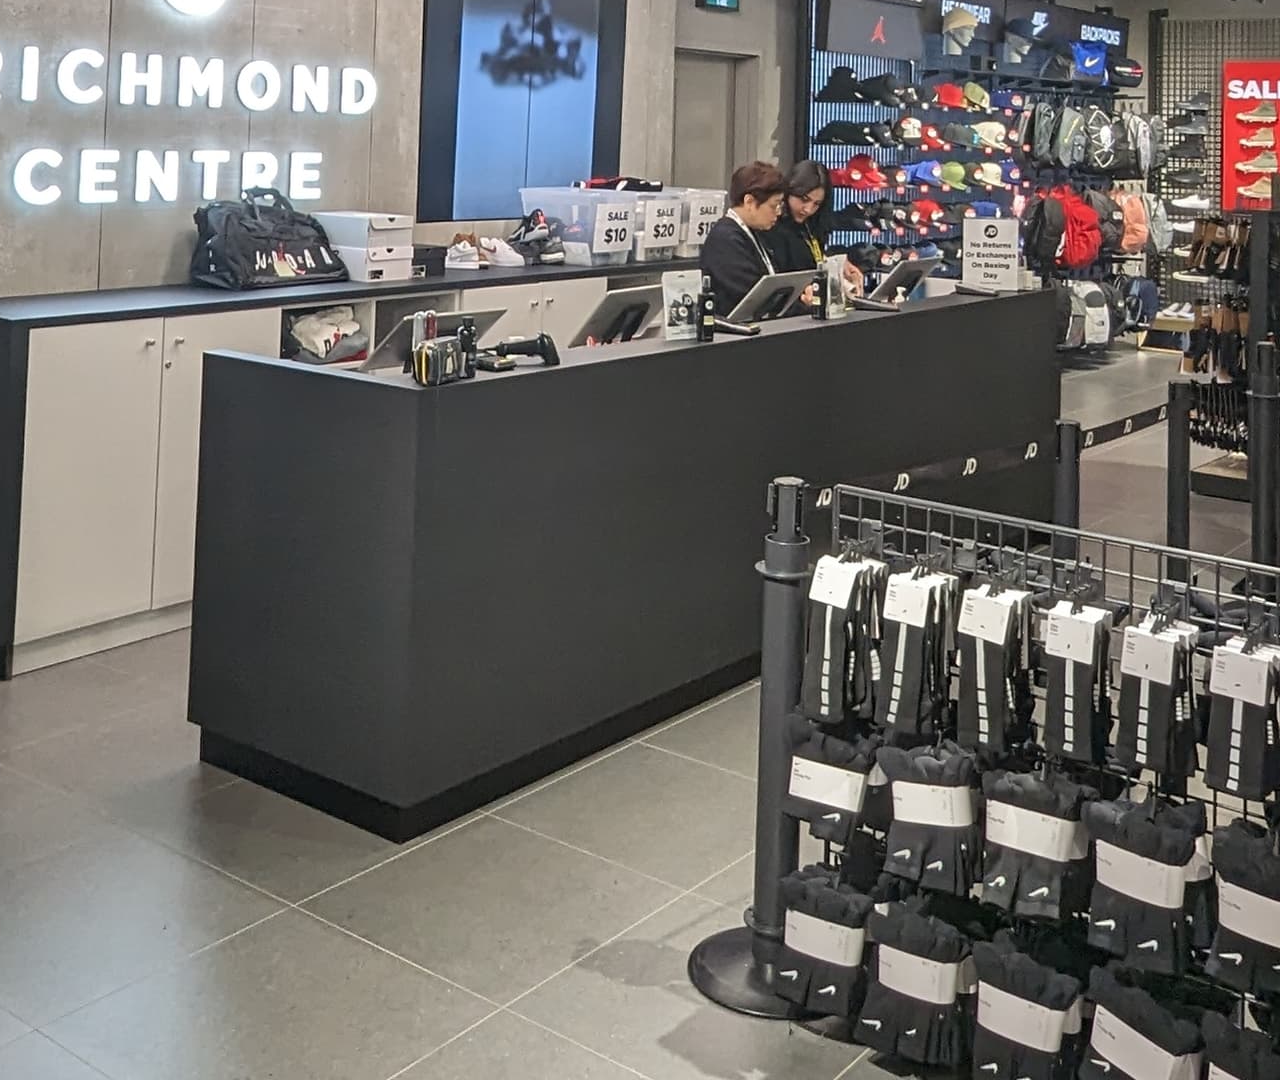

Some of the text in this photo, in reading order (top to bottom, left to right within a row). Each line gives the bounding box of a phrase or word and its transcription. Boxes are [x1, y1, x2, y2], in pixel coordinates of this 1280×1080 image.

[13, 148, 324, 206] CENTRE
[607, 211, 629, 222] SALE
[656, 207, 675, 218] SALE
[699, 206, 718, 216] SALE
[653, 223, 675, 239] $20
[697, 221, 717, 237] $1
[604, 227, 627, 244] $10
[976, 251, 1017, 260] Exchanges
[983, 262, 1010, 270] Boxing
